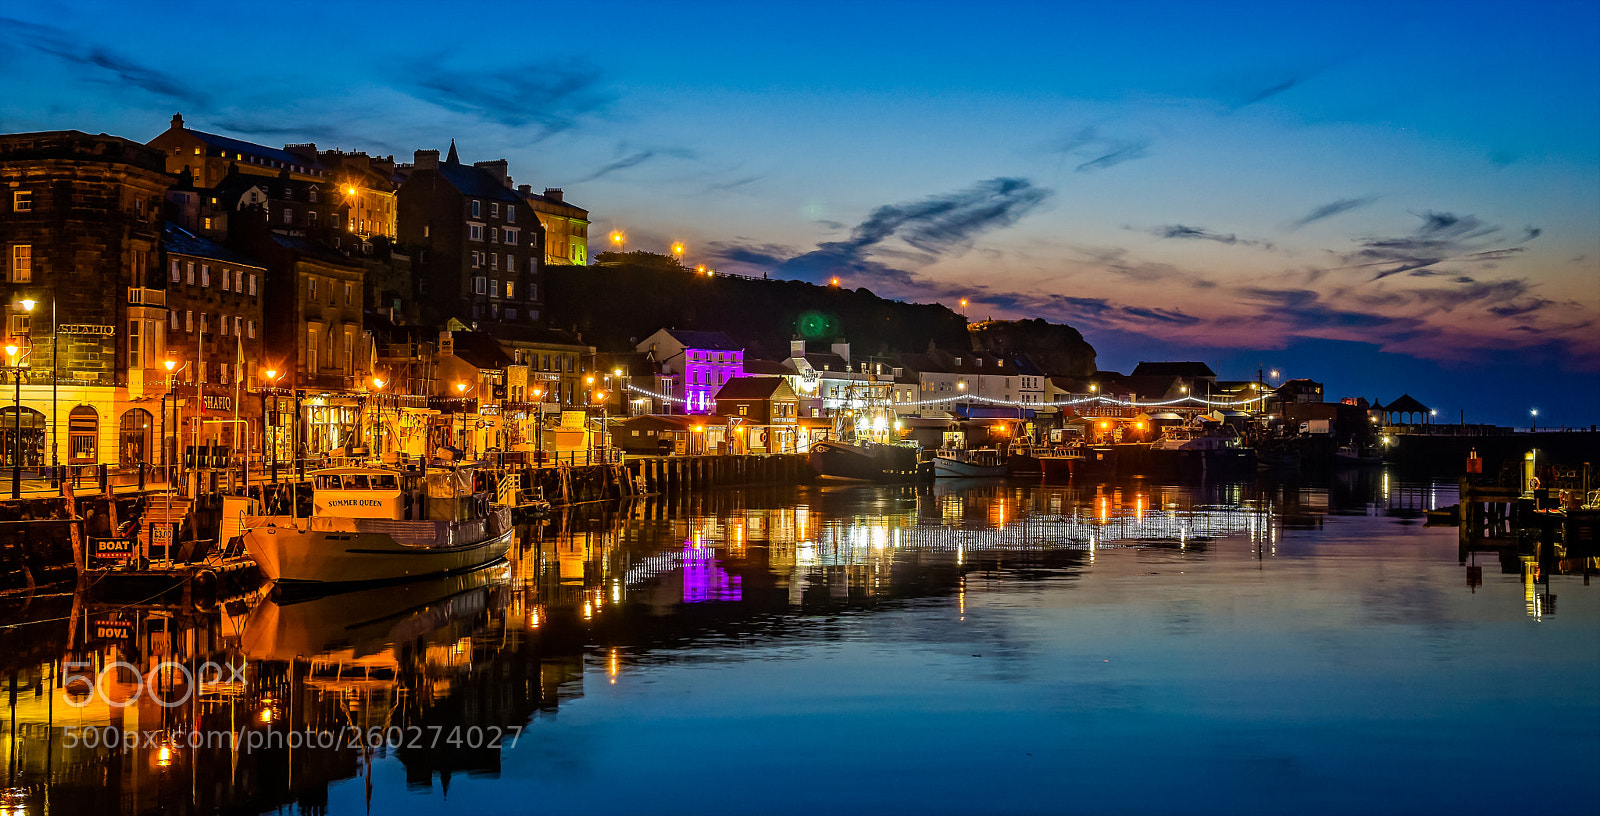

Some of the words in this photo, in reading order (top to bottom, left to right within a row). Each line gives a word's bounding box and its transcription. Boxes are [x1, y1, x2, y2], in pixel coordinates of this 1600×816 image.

[60, 324, 115, 337] SHAFIQ
[203, 395, 231, 411] SHAFIQ
[98, 541, 130, 551] BOAT
